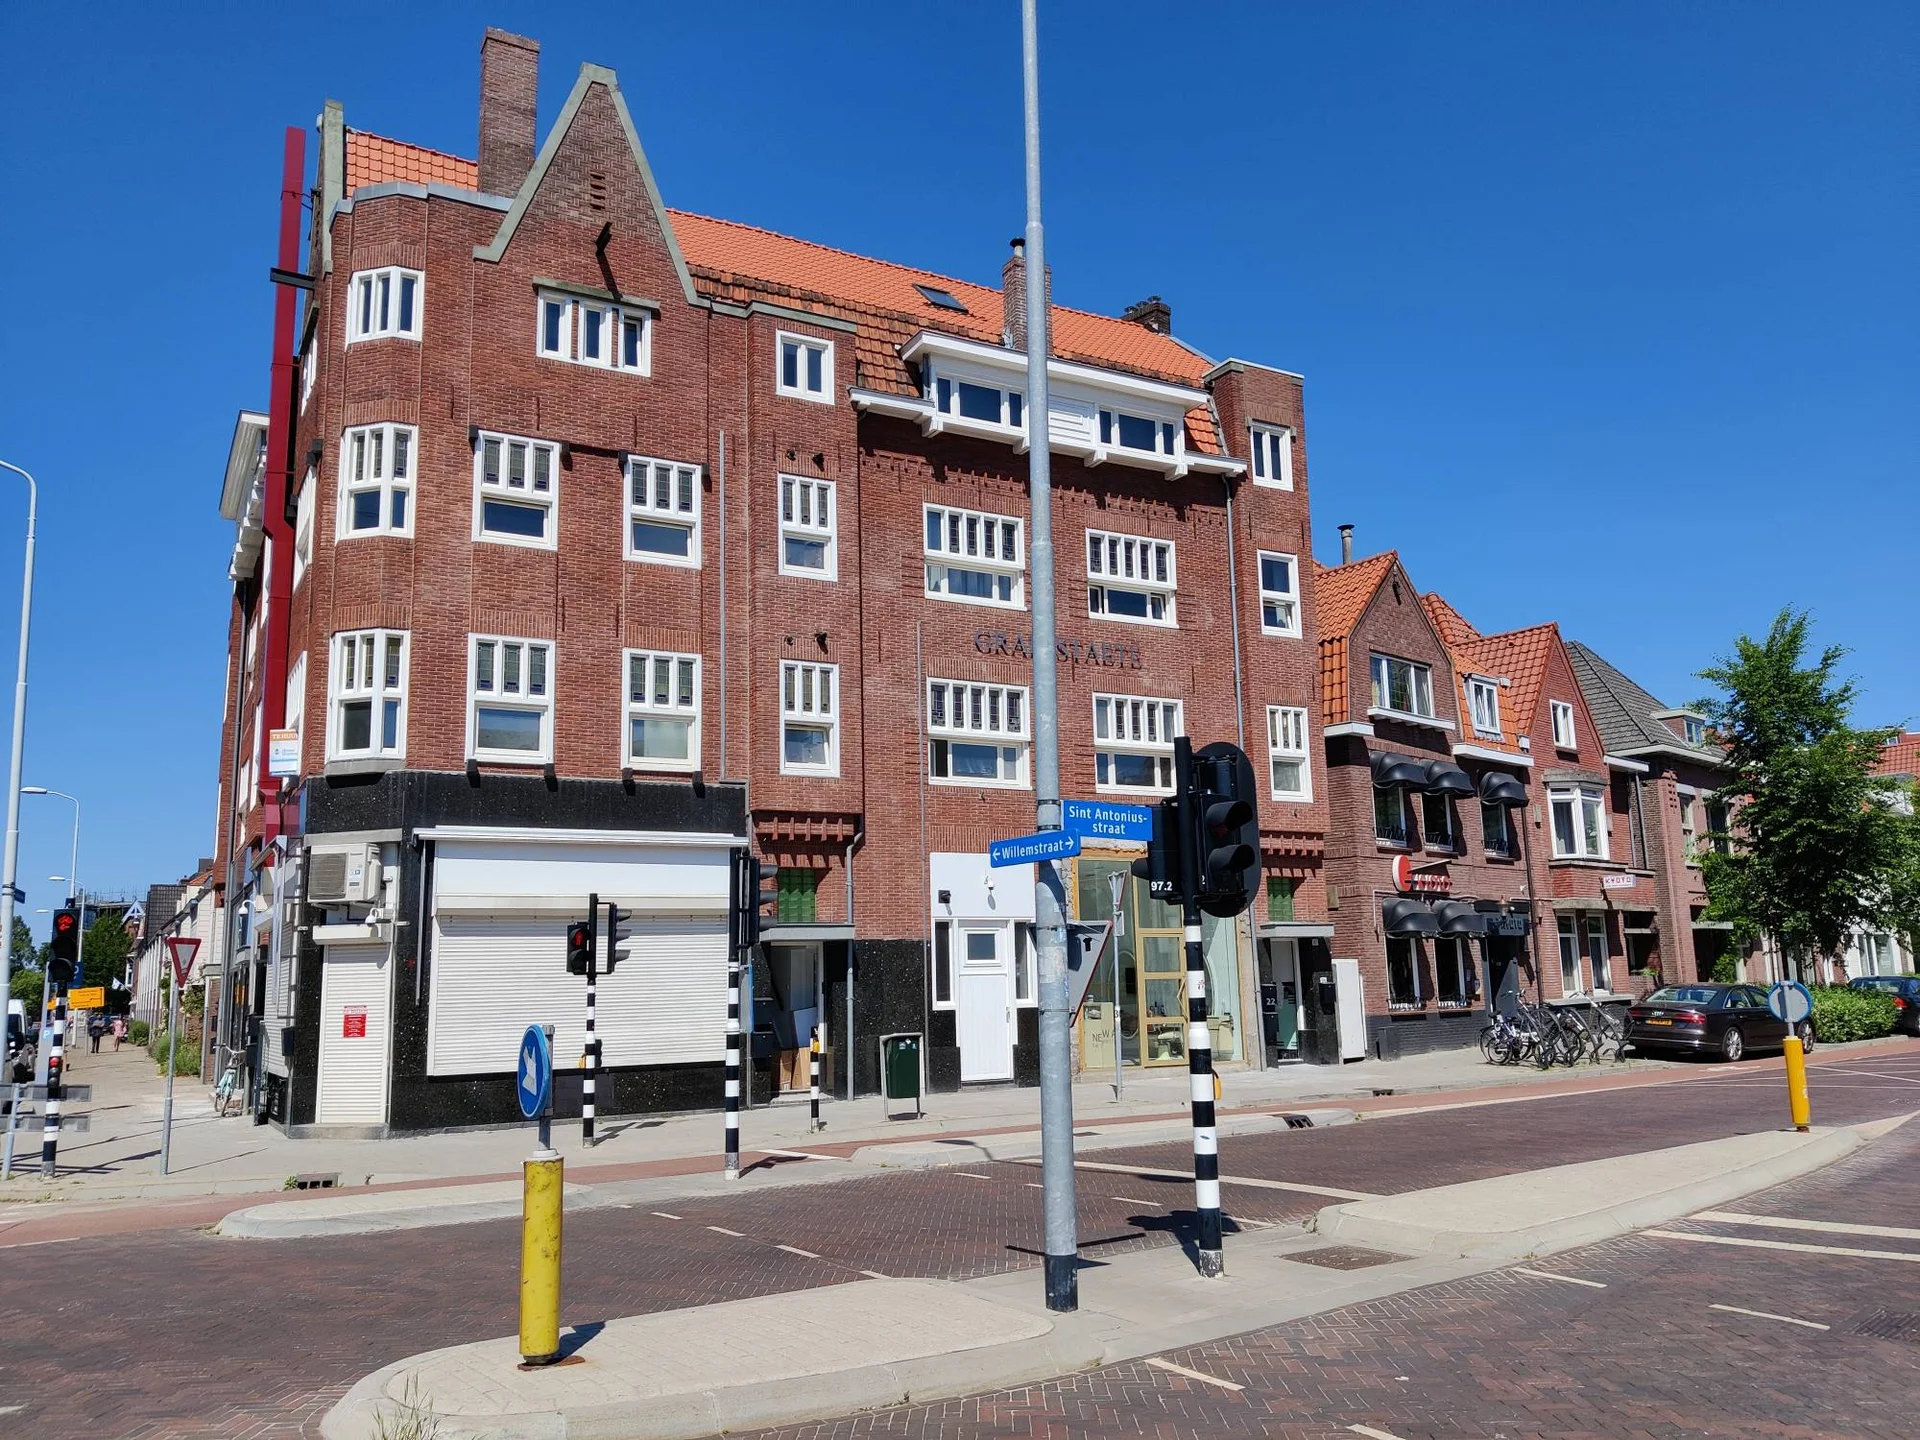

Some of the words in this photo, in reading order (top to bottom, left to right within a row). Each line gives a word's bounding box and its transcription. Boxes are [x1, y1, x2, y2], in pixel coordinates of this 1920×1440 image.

[1069, 805, 1092, 820] Sint
[1095, 807, 1148, 824] Antonius-
[1092, 822, 1126, 835] straat
[1001, 839, 1064, 859] Willemstraat
[1151, 881, 1173, 891] 97.2
[1266, 997, 1276, 1006] 22
[1092, 1029, 1110, 1043] NEW
